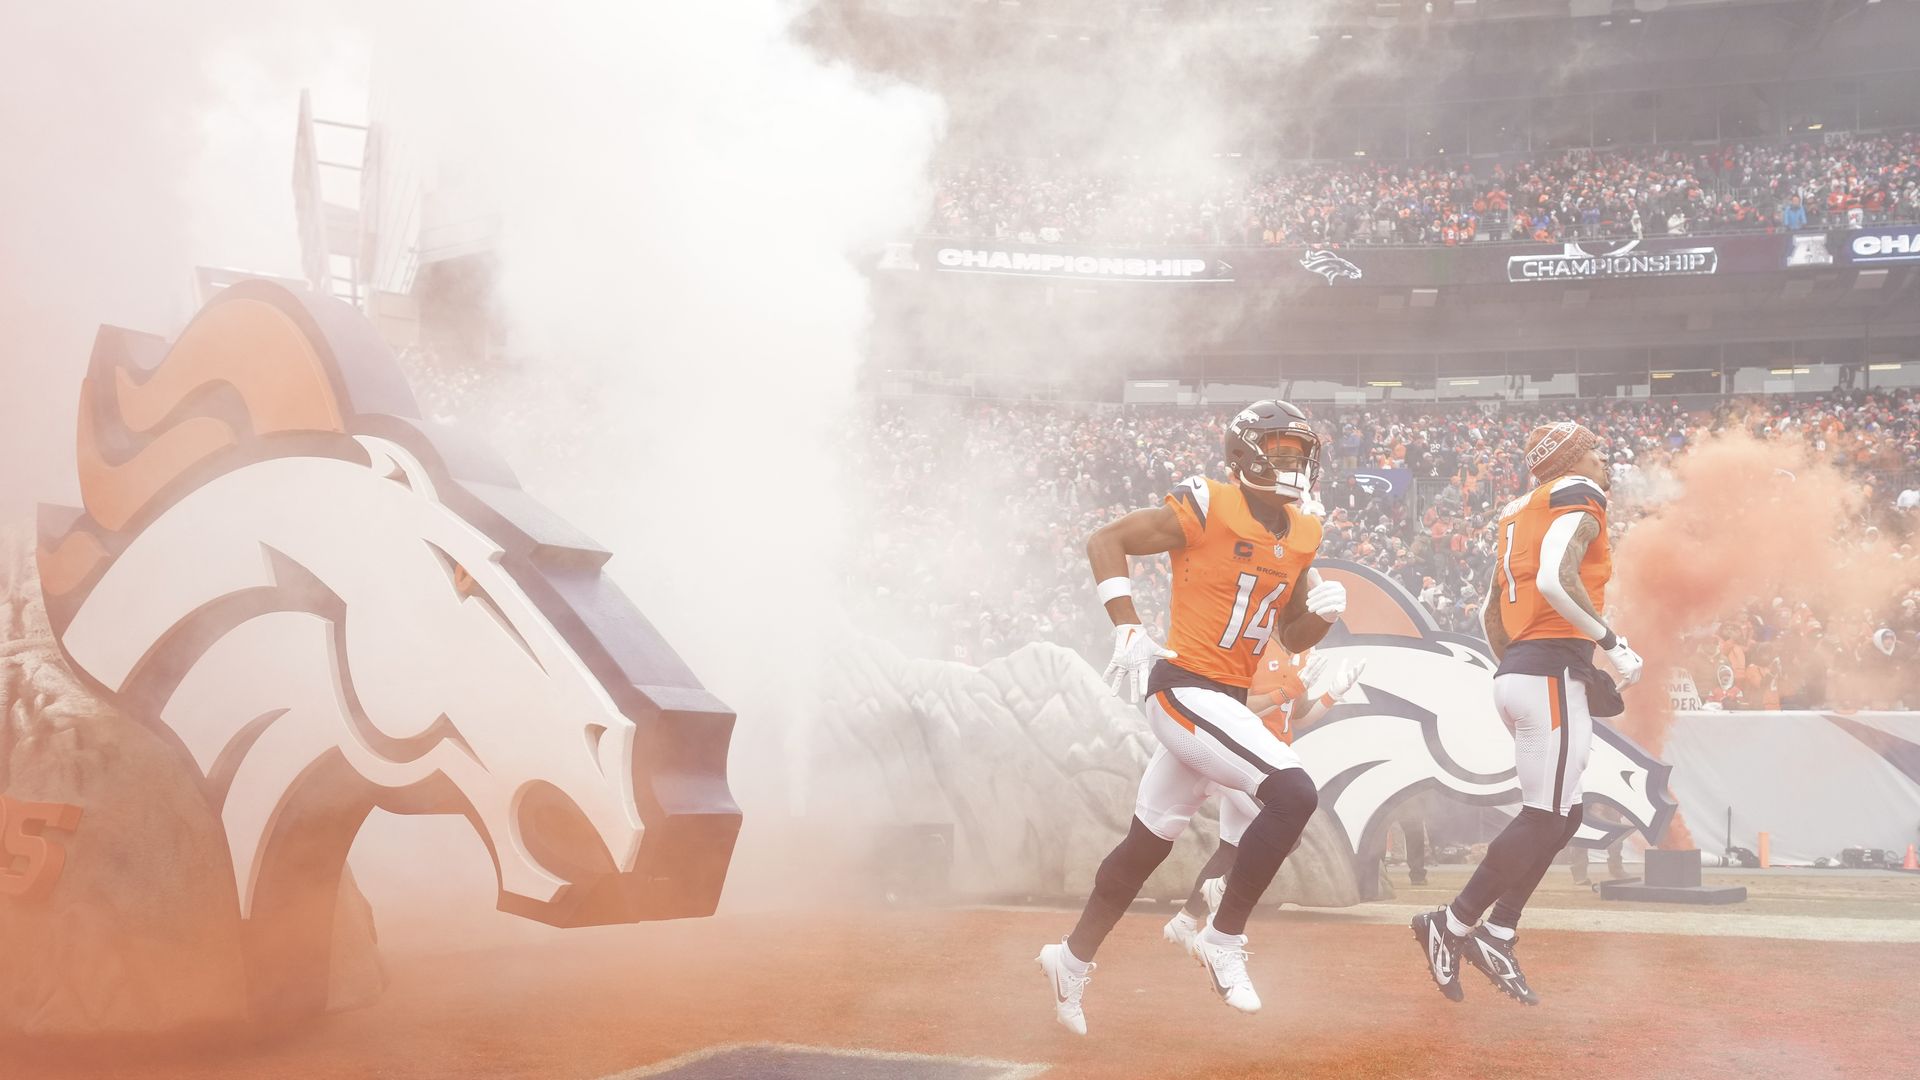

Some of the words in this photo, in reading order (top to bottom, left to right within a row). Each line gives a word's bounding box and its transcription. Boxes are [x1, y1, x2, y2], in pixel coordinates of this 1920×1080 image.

[937, 248, 1206, 276] CHAMPIONSHIP
[1522, 254, 1706, 278] CHAMPIONSHIP
[1233, 540, 1254, 558] C
[1502, 521, 1517, 604] 1
[1218, 571, 1288, 656] 14
[1268, 660, 1280, 672] C
[0, 796, 83, 903] S
